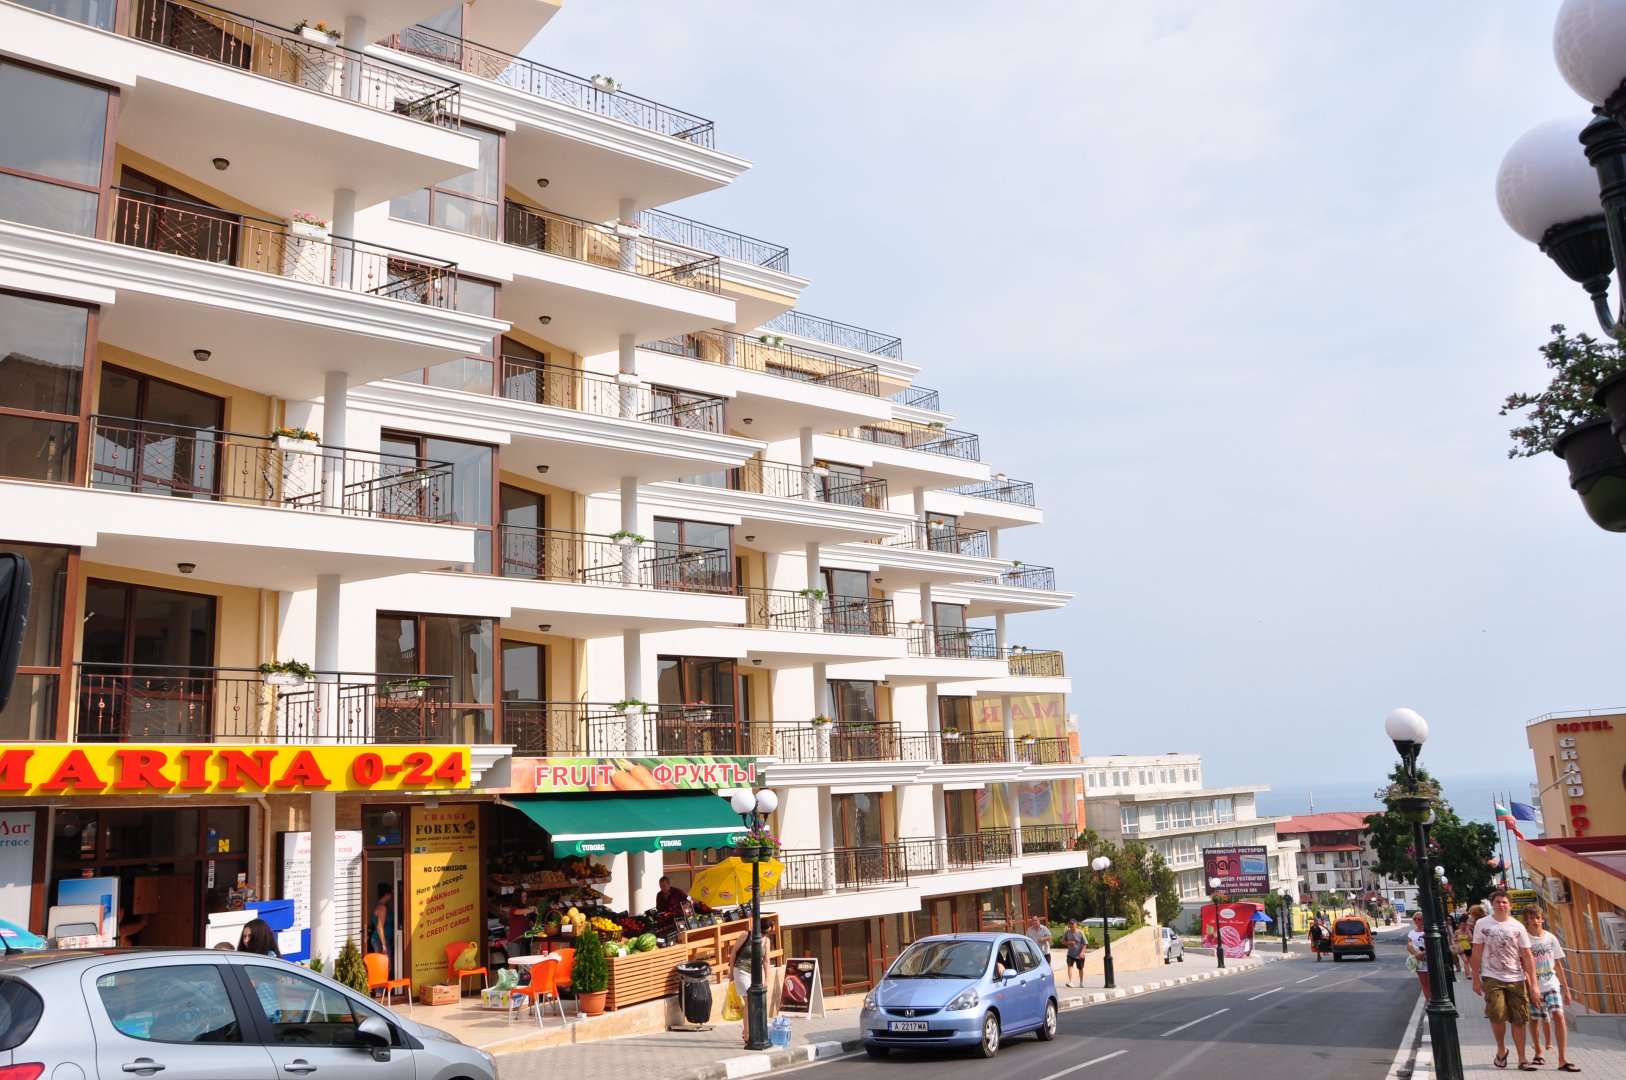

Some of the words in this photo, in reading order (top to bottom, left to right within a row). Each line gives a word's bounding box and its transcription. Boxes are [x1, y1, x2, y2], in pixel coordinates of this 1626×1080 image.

[1556, 720, 1613, 733] HOTEL
[352, 751, 466, 785] 0-24
[653, 763, 756, 784] ФРУКТЫ
[1558, 735, 1585, 798] GRAND
[535, 765, 615, 787] FRUIT
[415, 823, 460, 835] FOREX
[581, 842, 605, 851] TUBORG
[660, 839, 682, 848] TUBORG
[433, 864, 468, 873] COMMISSION
[1207, 860, 1239, 872] nar
[416, 886, 431, 895] Here
[442, 874, 464, 887] accept:
[425, 888, 460, 905] BANKNotes
[425, 903, 446, 916] COINS
[425, 915, 445, 927] Travel
[445, 903, 474, 919] CHEQUES
[425, 923, 449, 938] CREDIT
[449, 915, 471, 929] CARDS
[901, 1022, 917, 1030] 2217
